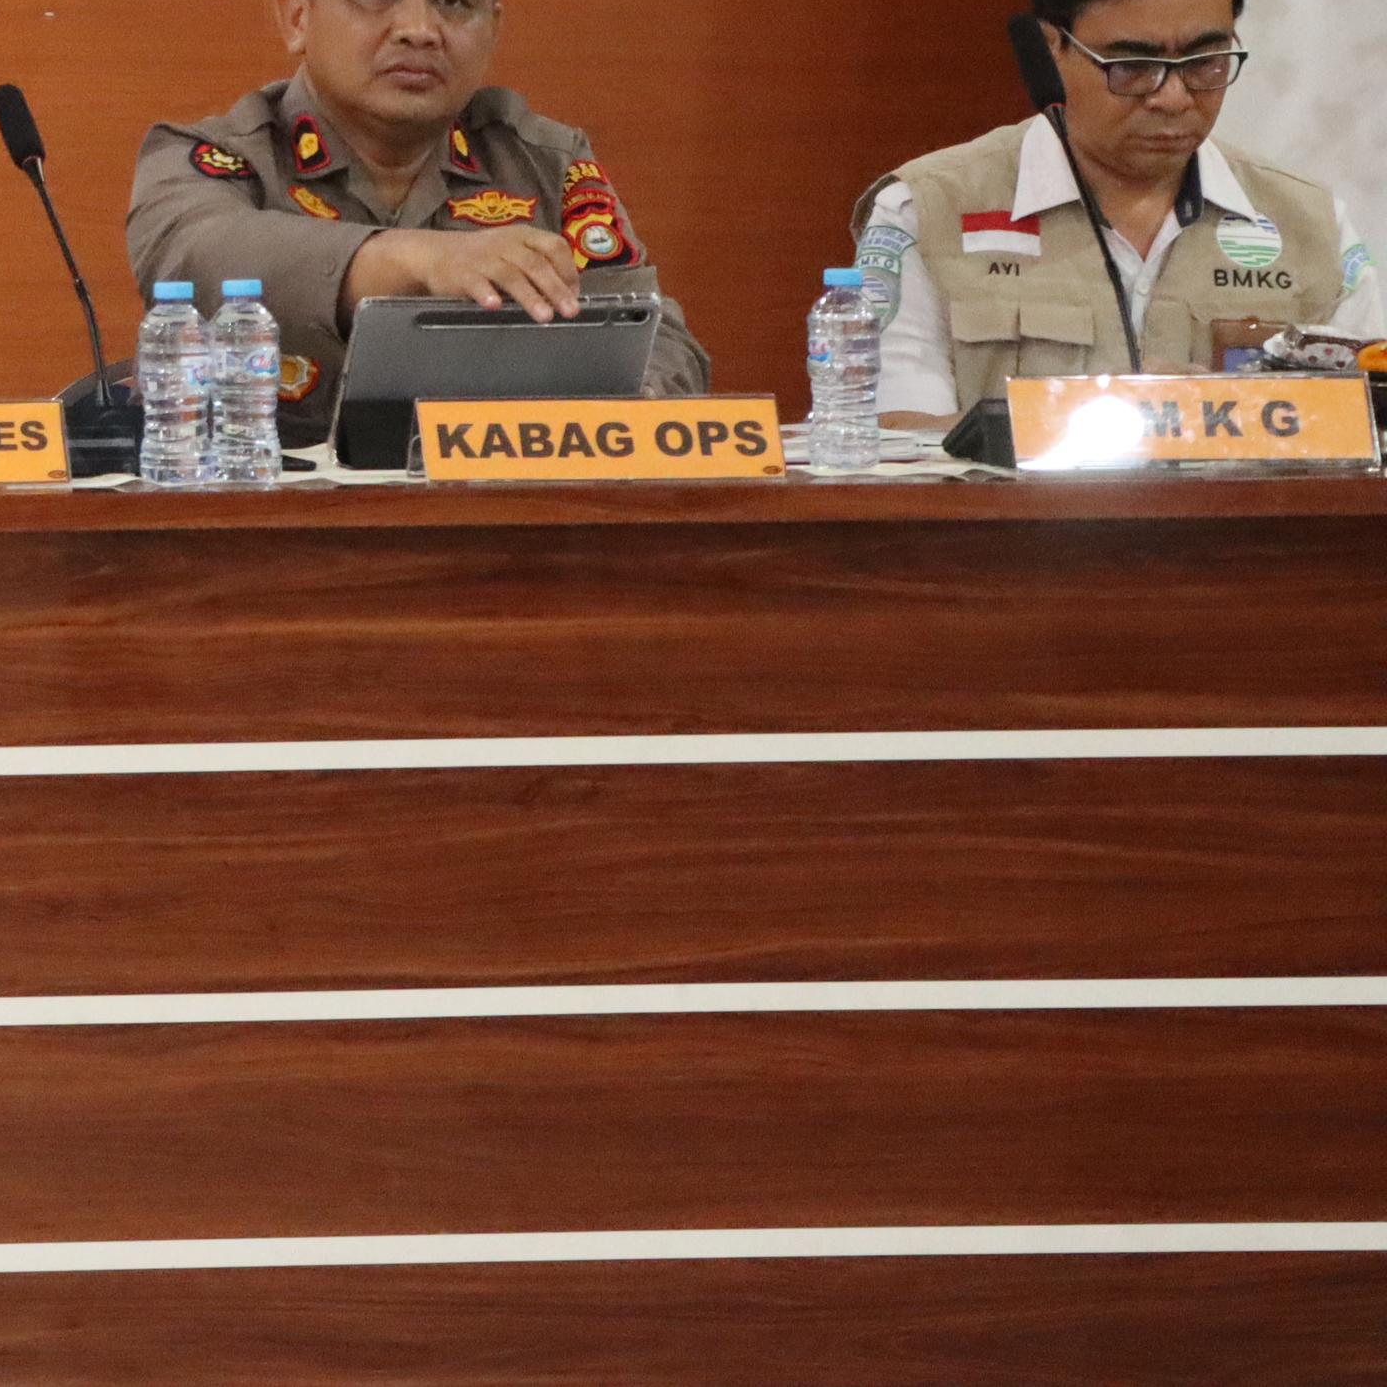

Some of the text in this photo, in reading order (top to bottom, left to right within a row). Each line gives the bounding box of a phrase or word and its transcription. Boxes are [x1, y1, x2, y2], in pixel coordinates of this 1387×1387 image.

[859, 256, 895, 270] MKG
[988, 261, 1020, 277] AYI
[1213, 268, 1293, 290] BMKG
[1080, 399, 1300, 439] MKG
[436, 420, 769, 459] KABAG OPS
